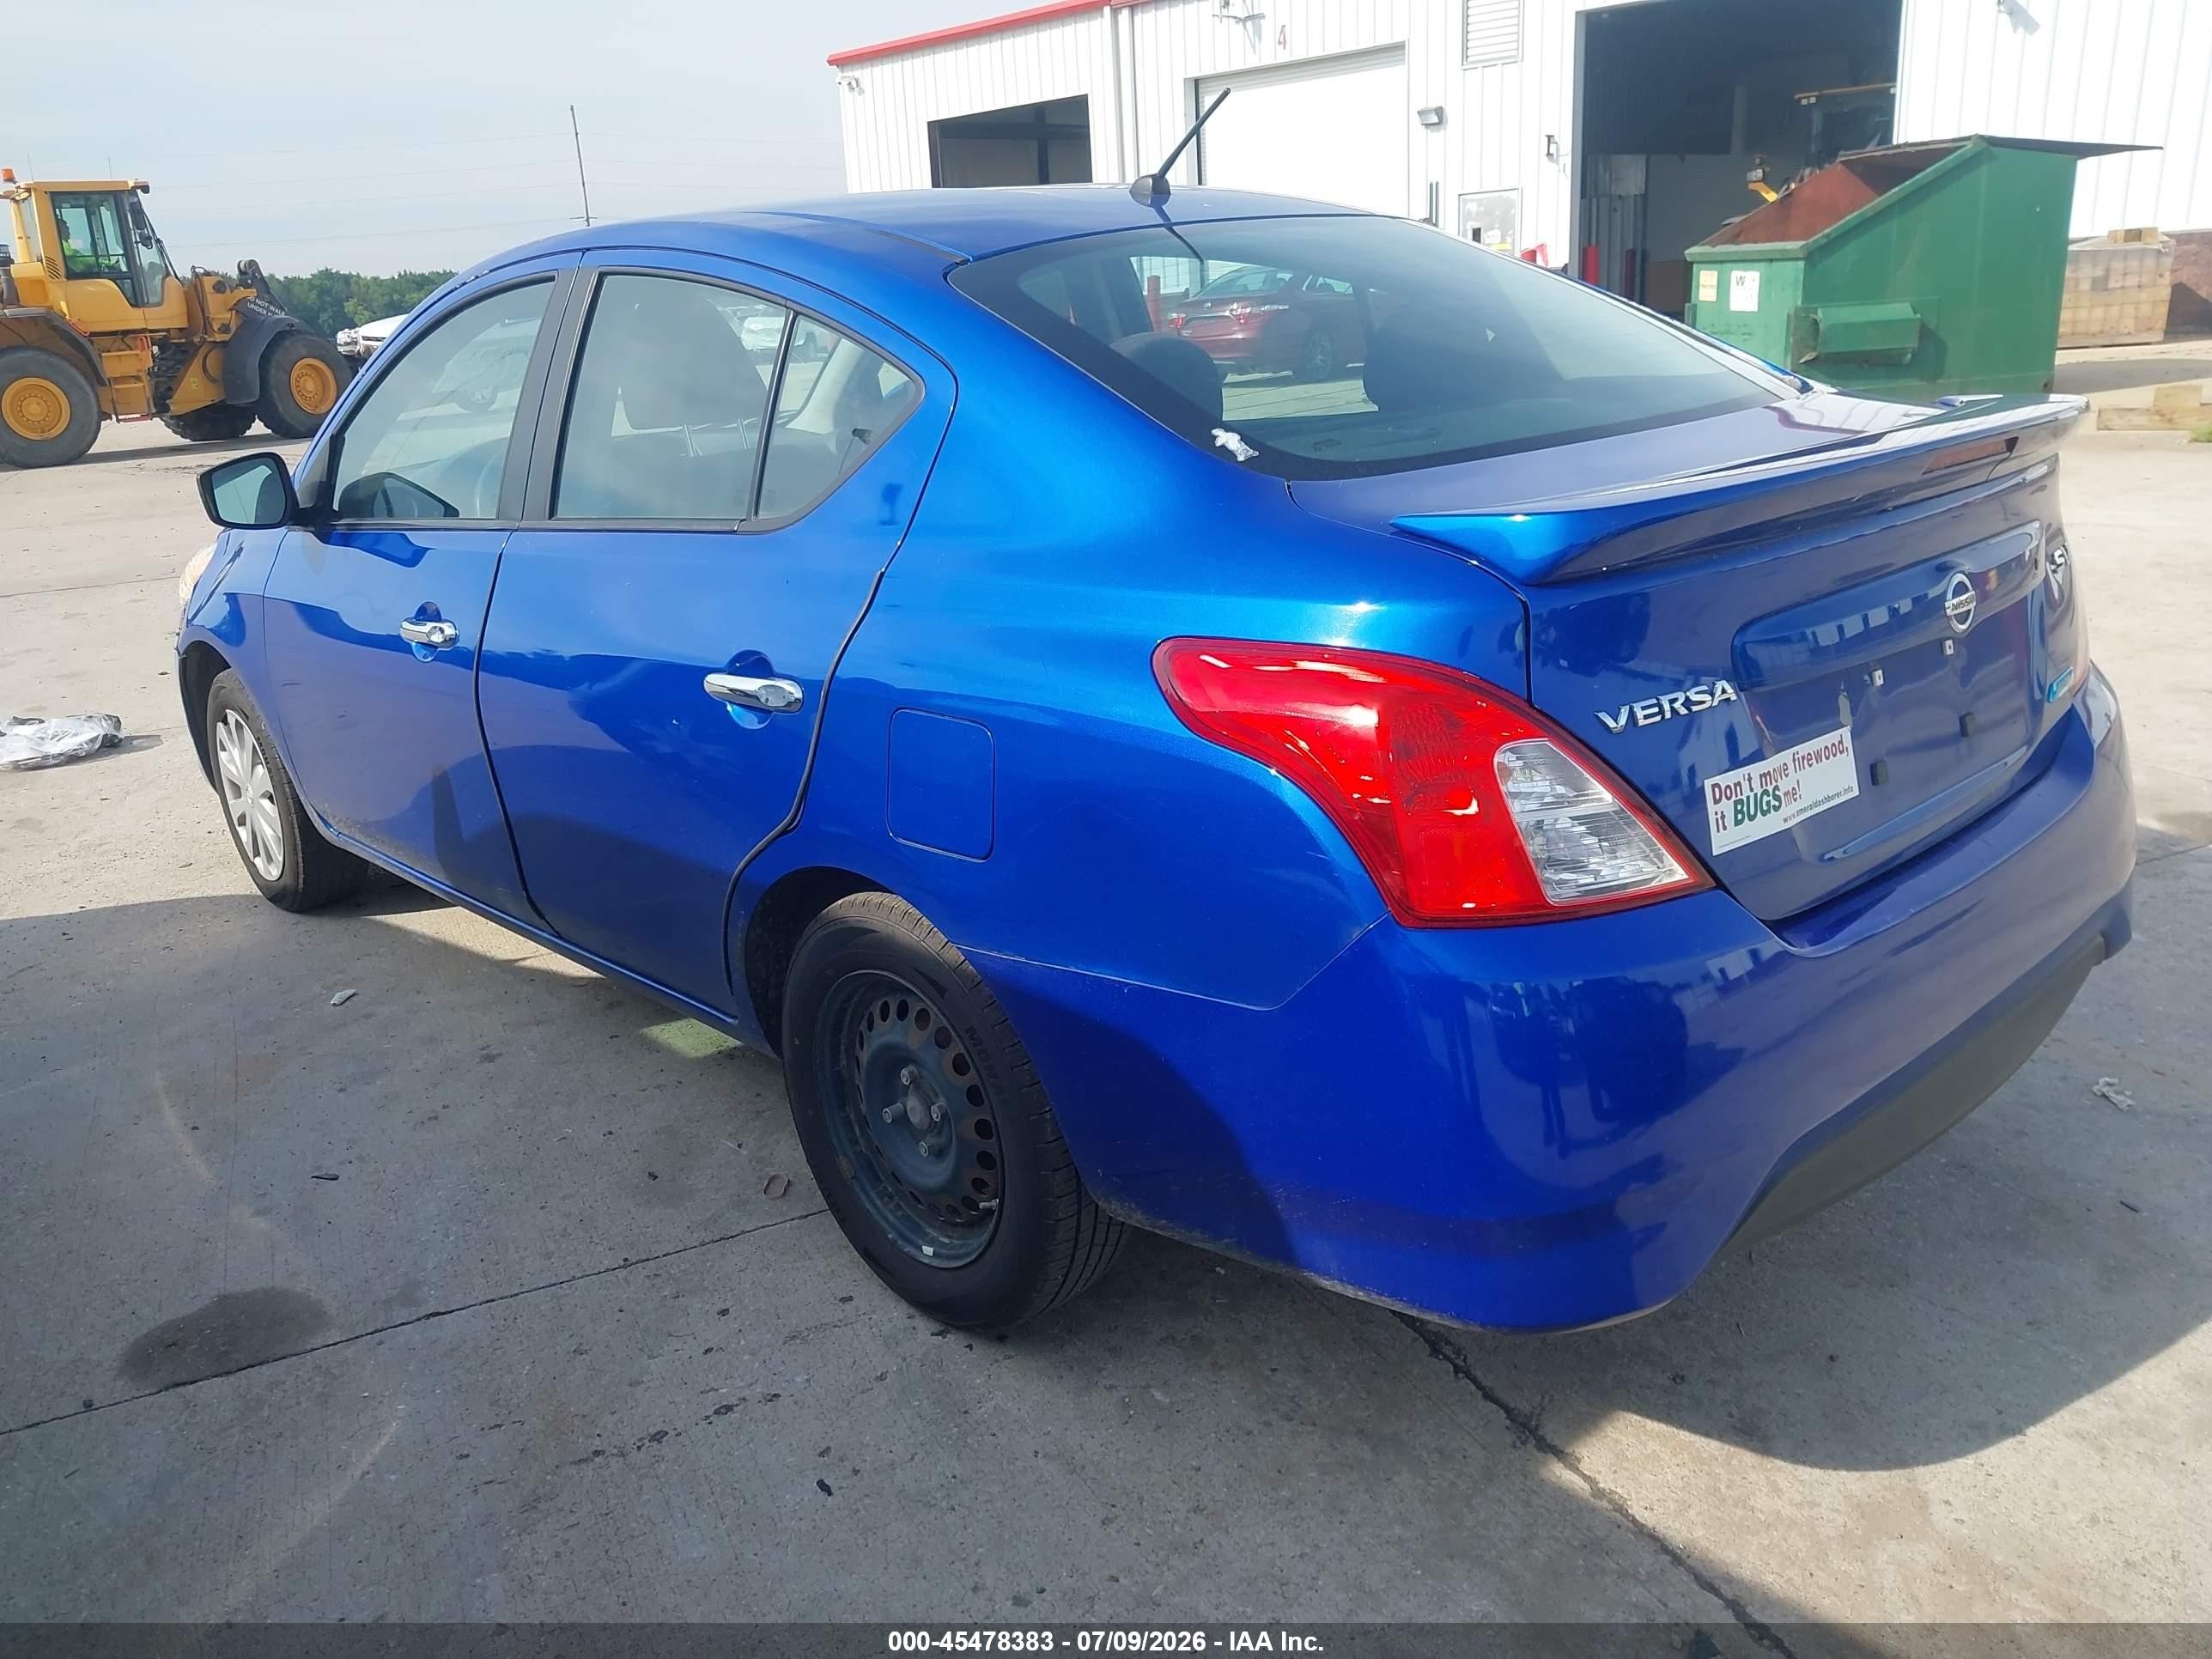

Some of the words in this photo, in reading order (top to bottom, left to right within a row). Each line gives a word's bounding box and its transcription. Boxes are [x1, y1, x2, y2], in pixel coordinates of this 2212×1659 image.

[1278, 24, 1286, 50] 4
[247, 301, 267, 315] UNDER
[256, 298, 269, 308] NOT
[1595, 679, 1738, 734] VERSA
[1711, 772, 1754, 805] Don't
[1759, 761, 1790, 790] move
[1792, 733, 1850, 774] firewood,
[1715, 810, 1728, 834] it
[1733, 784, 1783, 828] BUGS
[1784, 779, 1802, 808] me!
